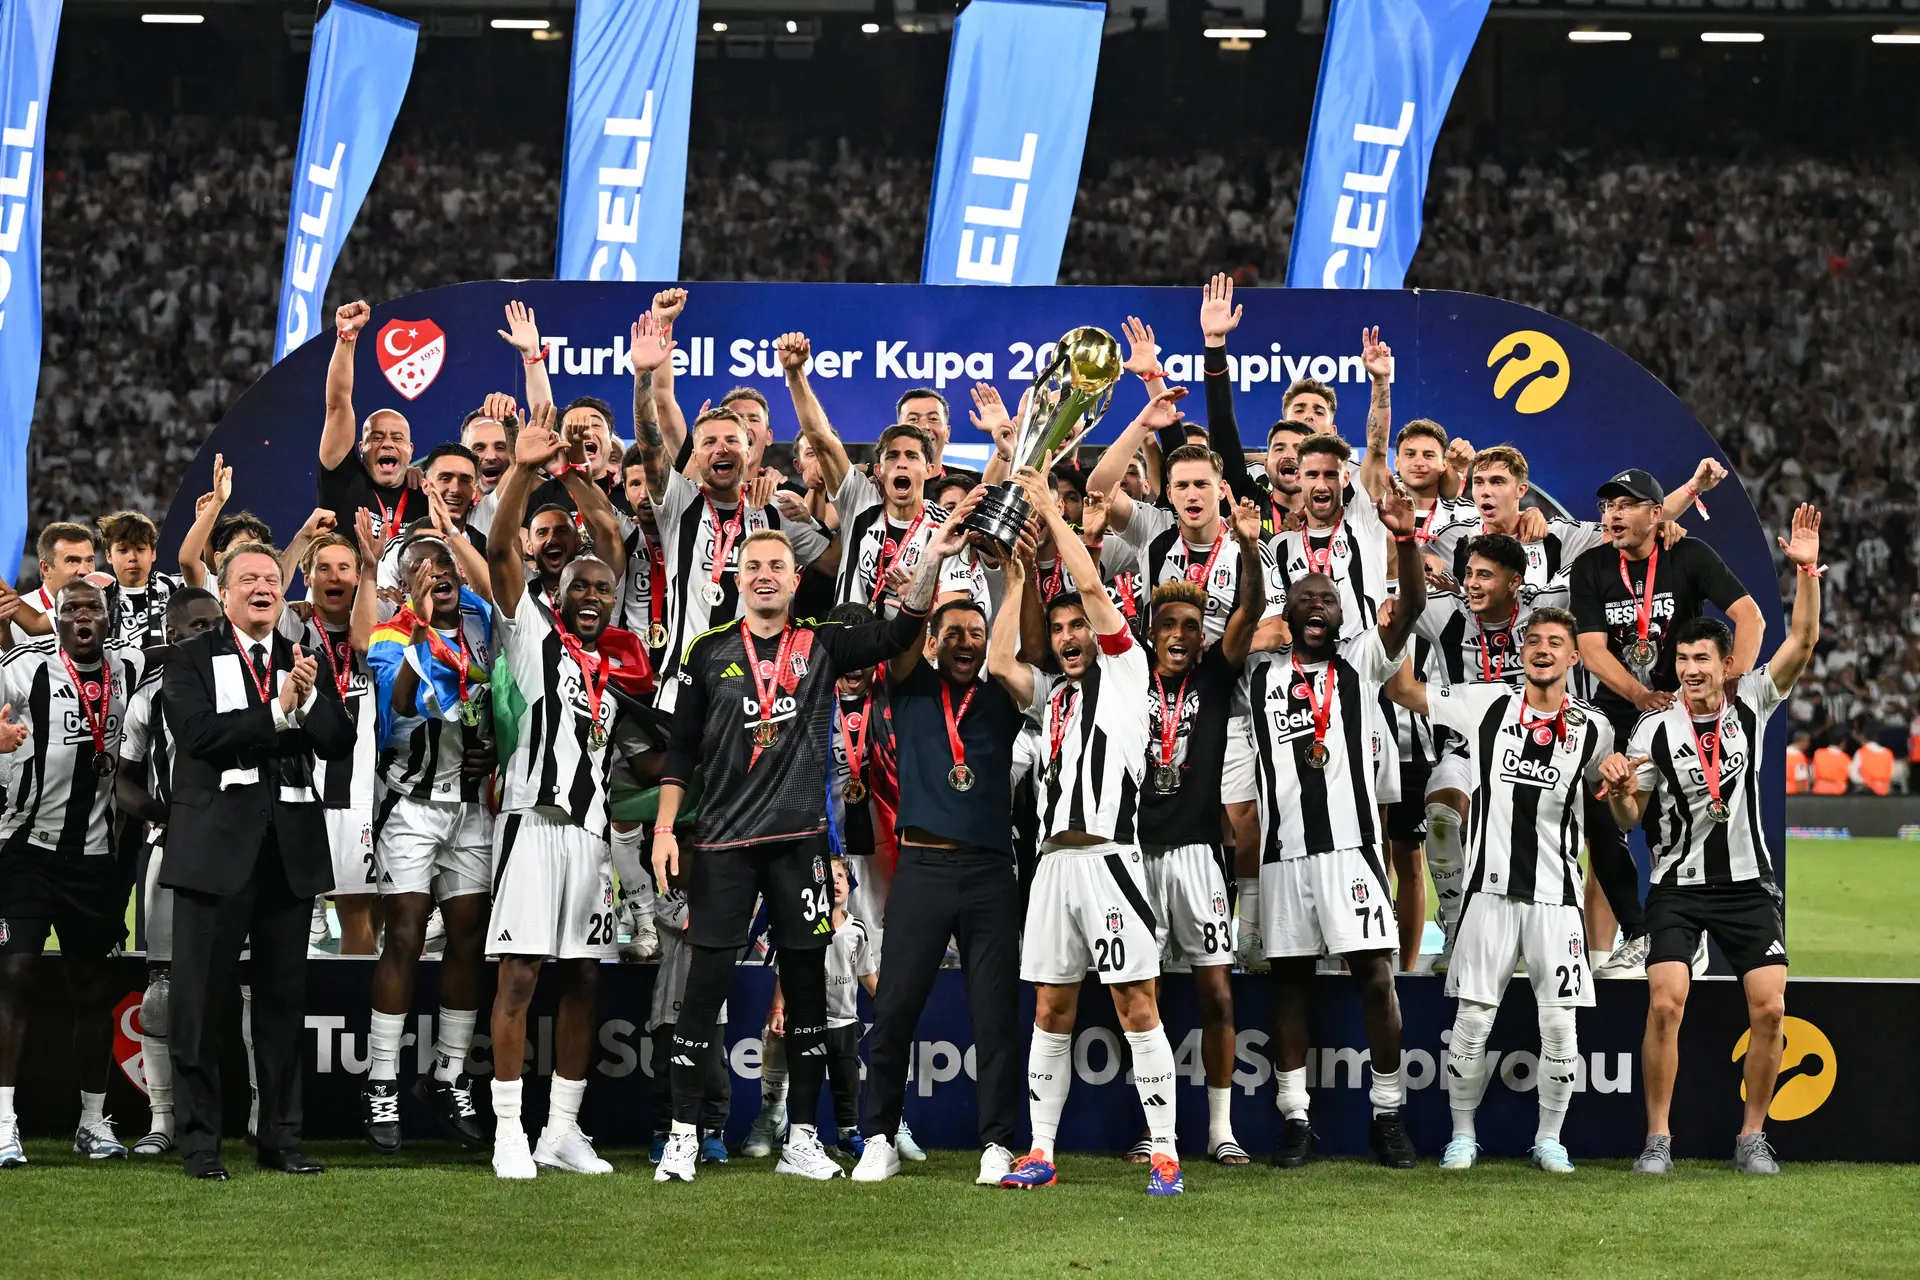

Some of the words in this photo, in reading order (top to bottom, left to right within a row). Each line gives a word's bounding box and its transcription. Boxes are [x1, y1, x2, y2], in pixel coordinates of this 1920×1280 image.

[0, 101, 39, 303] ELL
[420, 346, 440, 361] 1923
[541, 336, 714, 376] Turkell
[876, 341, 993, 389] Kupa
[565, 676, 610, 720] beo
[743, 696, 796, 715] bko
[64, 710, 119, 734] beo
[1274, 708, 1331, 731] bek
[1503, 748, 1560, 783] beko
[1689, 752, 1743, 786] bko
[801, 883, 830, 922] 34
[586, 912, 613, 946] 28
[1203, 920, 1231, 954] 83
[1355, 905, 1387, 939] 71
[1096, 937, 1126, 972] 20
[1556, 963, 1581, 999] 23
[1028, 1072, 1053, 1081] ara
